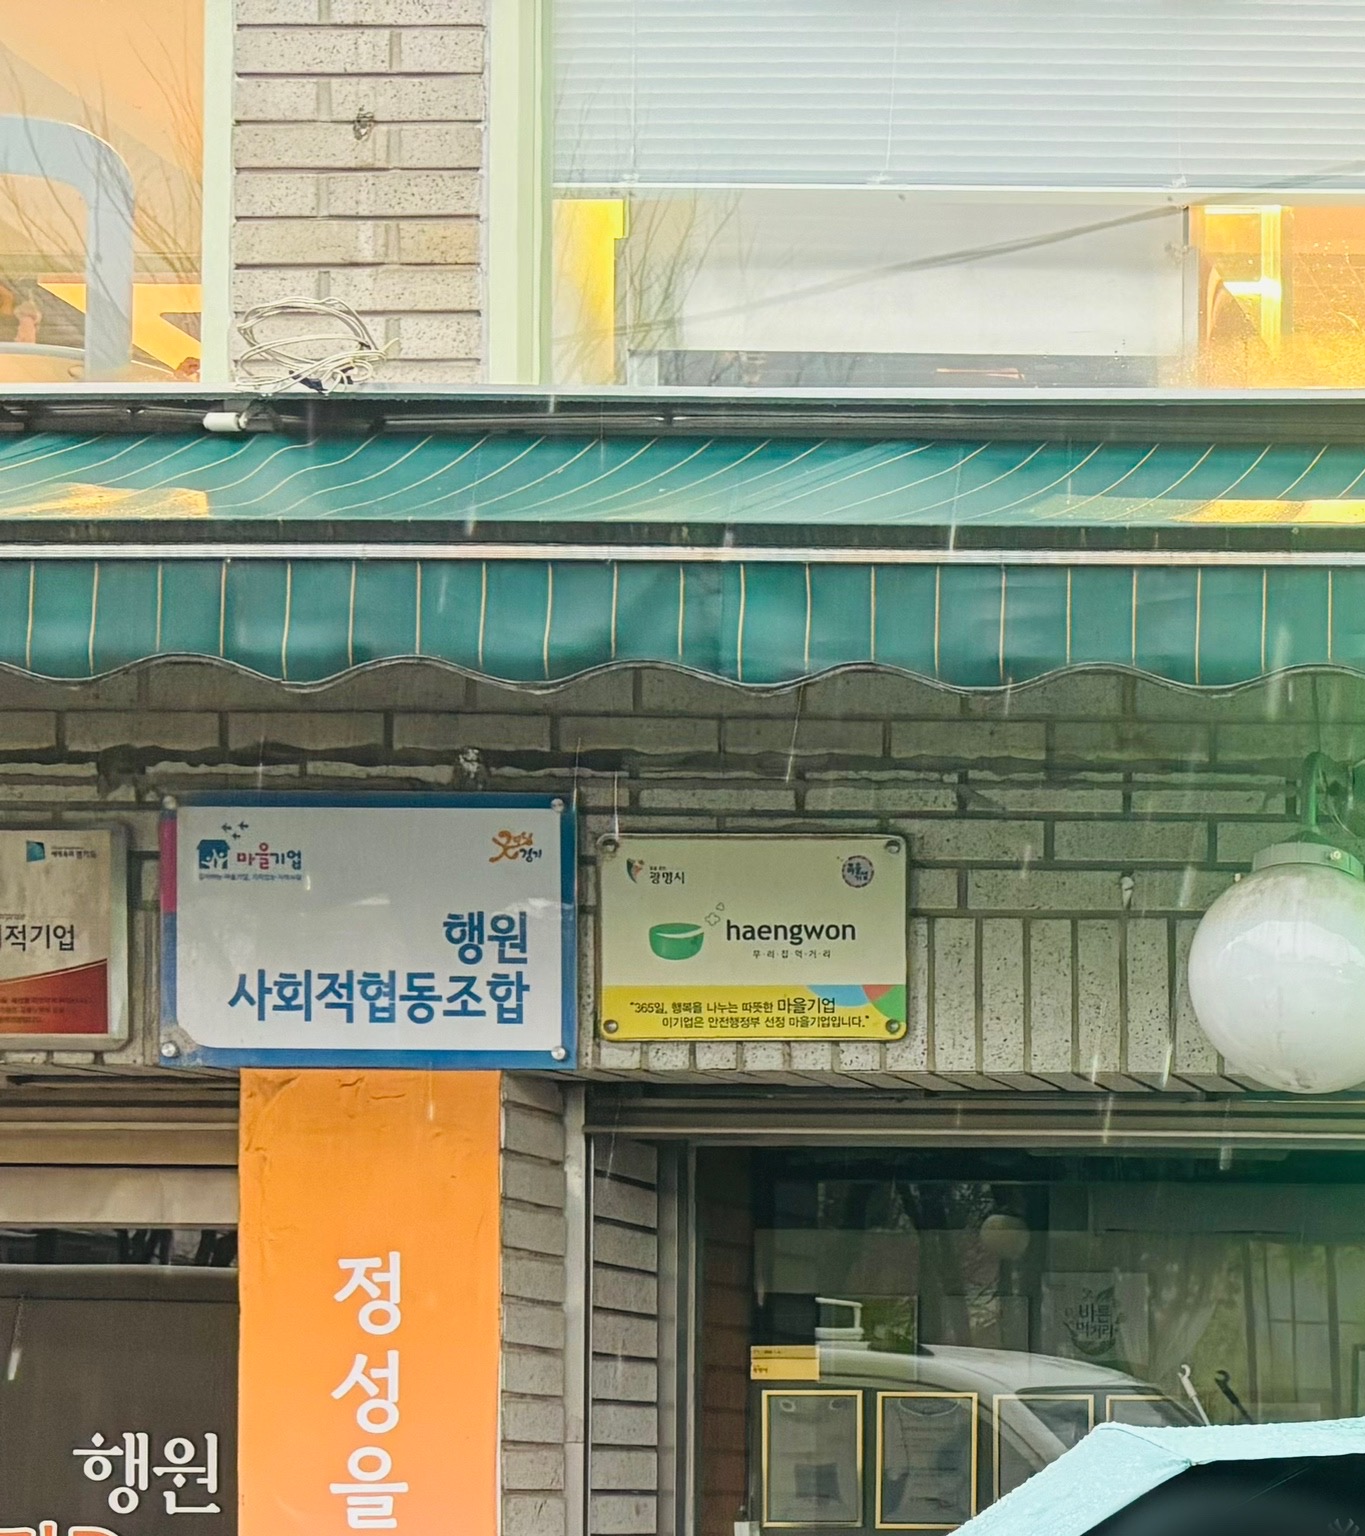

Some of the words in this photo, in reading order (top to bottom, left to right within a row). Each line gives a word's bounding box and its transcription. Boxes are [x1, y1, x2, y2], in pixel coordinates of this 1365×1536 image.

[236, 842, 302, 871] 마을기업
[0, 924, 75, 951] 적기업
[442, 911, 528, 965] 행원
[726, 919, 856, 946] haengwon
[228, 969, 530, 1025] 사회적협동조합
[671, 1002, 703, 1014] 행복을
[706, 1002, 739, 1014] 나누는
[742, 1002, 773, 1014] 따뜻한
[777, 997, 836, 1014] 마을기업
[662, 1017, 704, 1029] 이기업은
[708, 1017, 761, 1029] 안전행정부
[764, 1017, 786, 1029] 선정
[330, 1252, 407, 1530] 정성을
[72, 1432, 221, 1515] 행원
